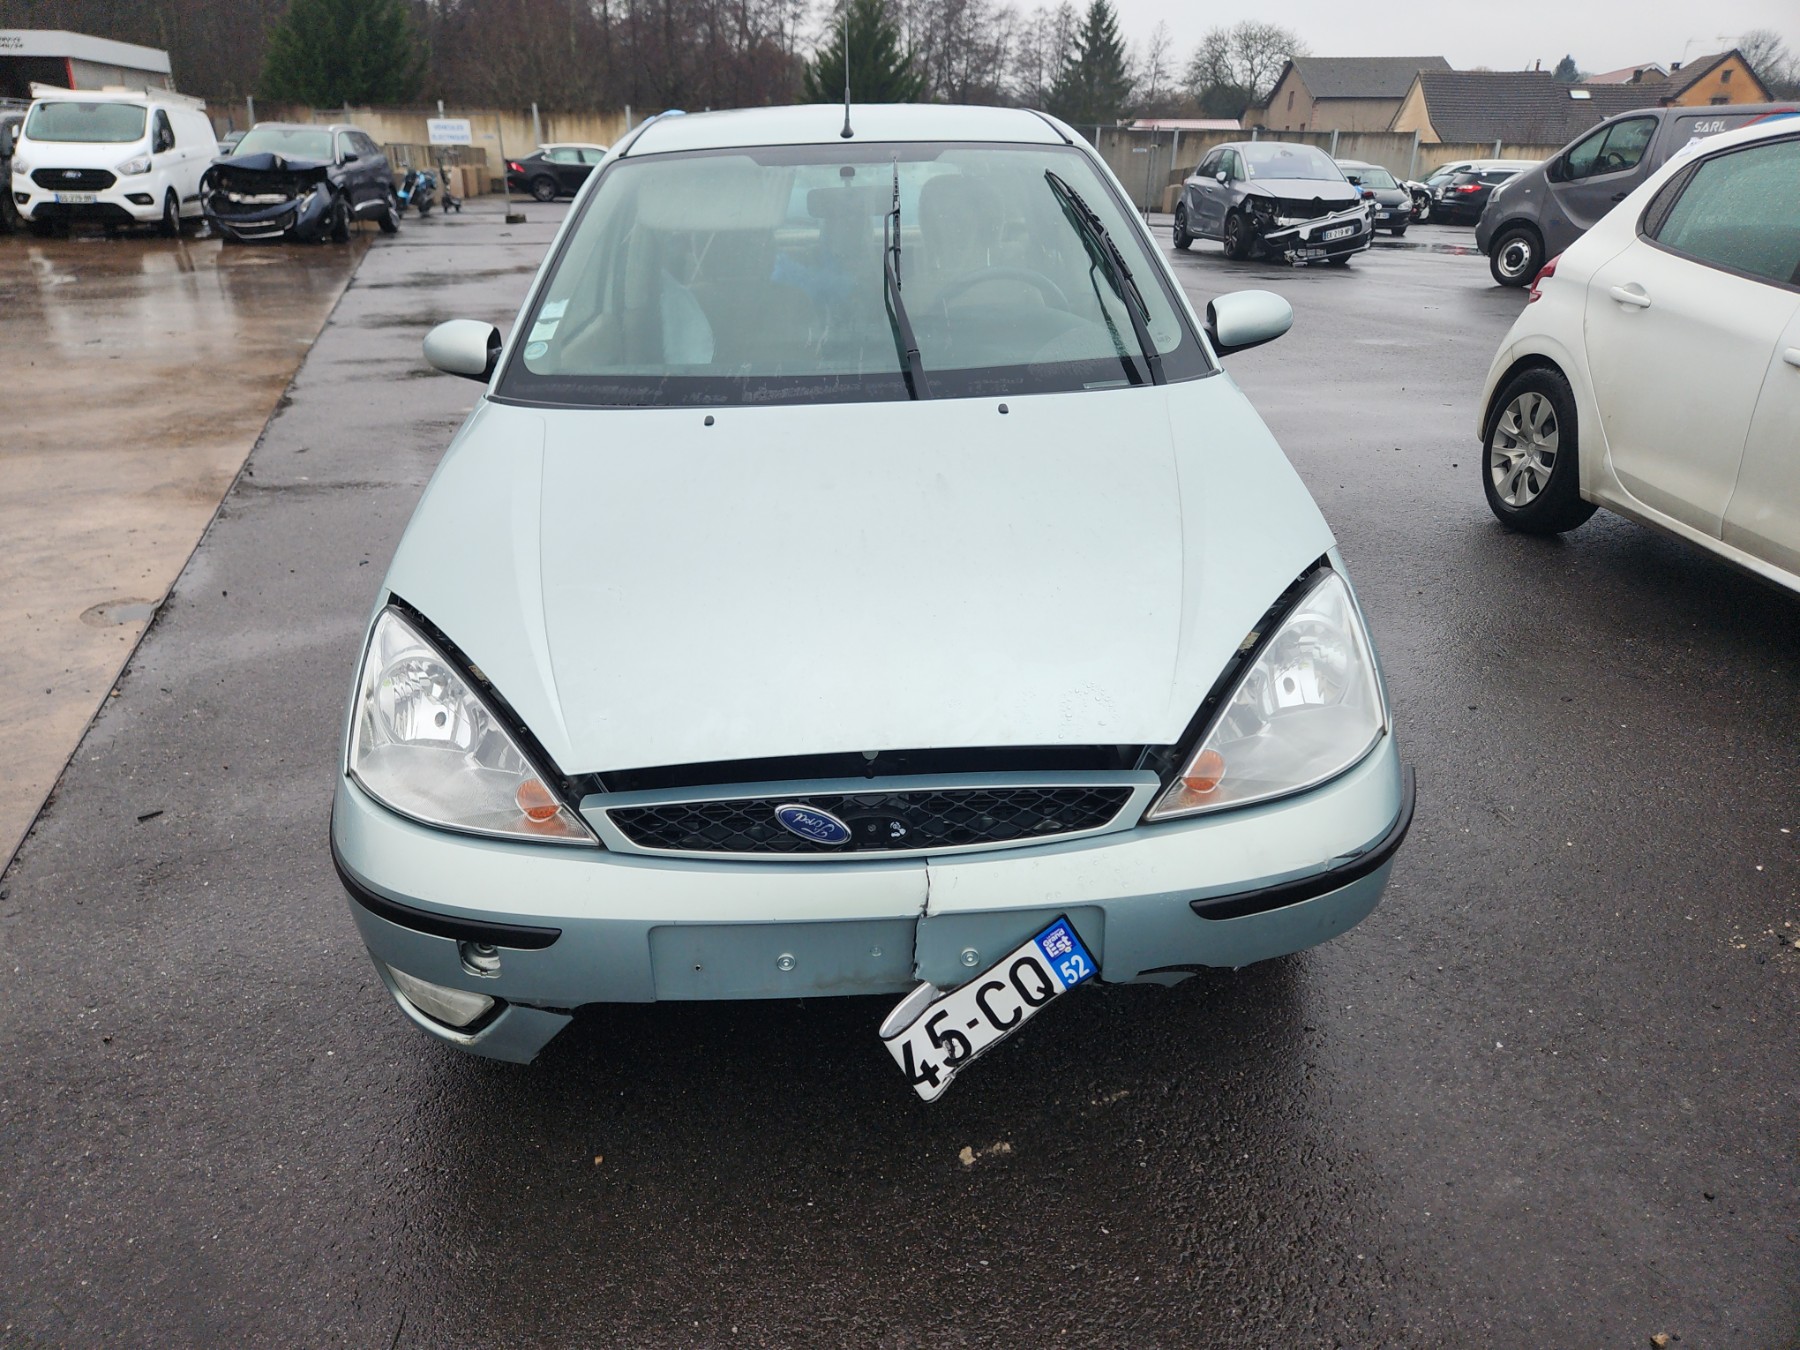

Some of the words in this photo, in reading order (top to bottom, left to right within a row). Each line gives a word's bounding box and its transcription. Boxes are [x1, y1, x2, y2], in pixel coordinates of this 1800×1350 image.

[1693, 121, 1726, 133] SARL
[793, 812, 836, 838] Ford
[1060, 954, 1090, 984] 52
[902, 957, 1058, 1088] 45-CQ
